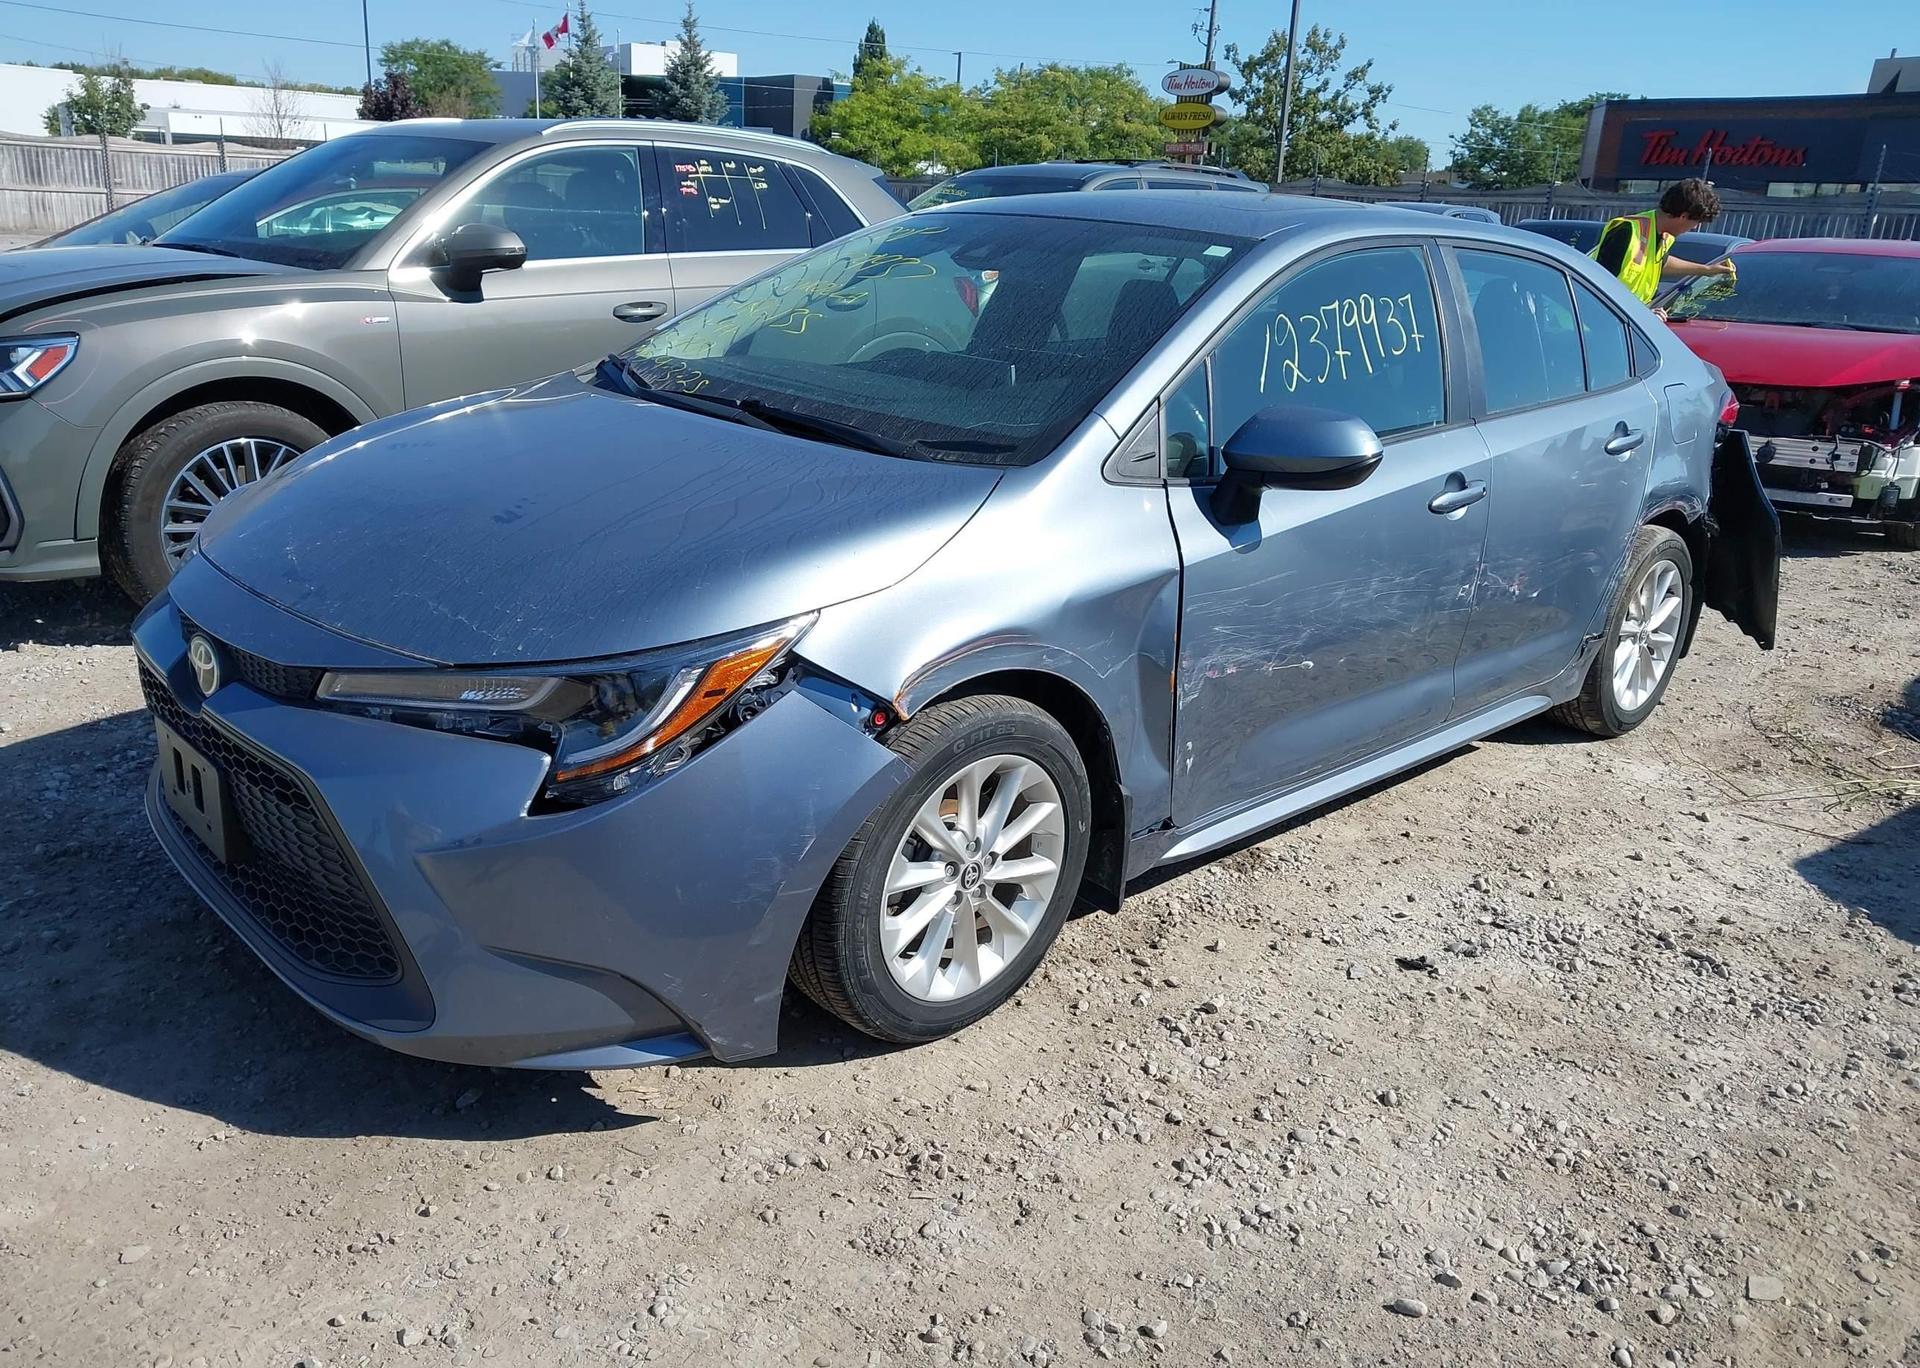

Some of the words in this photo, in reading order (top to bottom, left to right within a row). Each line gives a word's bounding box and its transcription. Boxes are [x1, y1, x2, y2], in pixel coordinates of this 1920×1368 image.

[1166, 75, 1182, 91] Tim
[1183, 74, 1215, 91] Hortons
[1162, 111, 1187, 121] ALWAYS
[1188, 111, 1212, 121] FRESH
[1641, 129, 1689, 167] Tim
[1691, 128, 1808, 168] Hortons
[1260, 293, 1425, 394] 12379937
